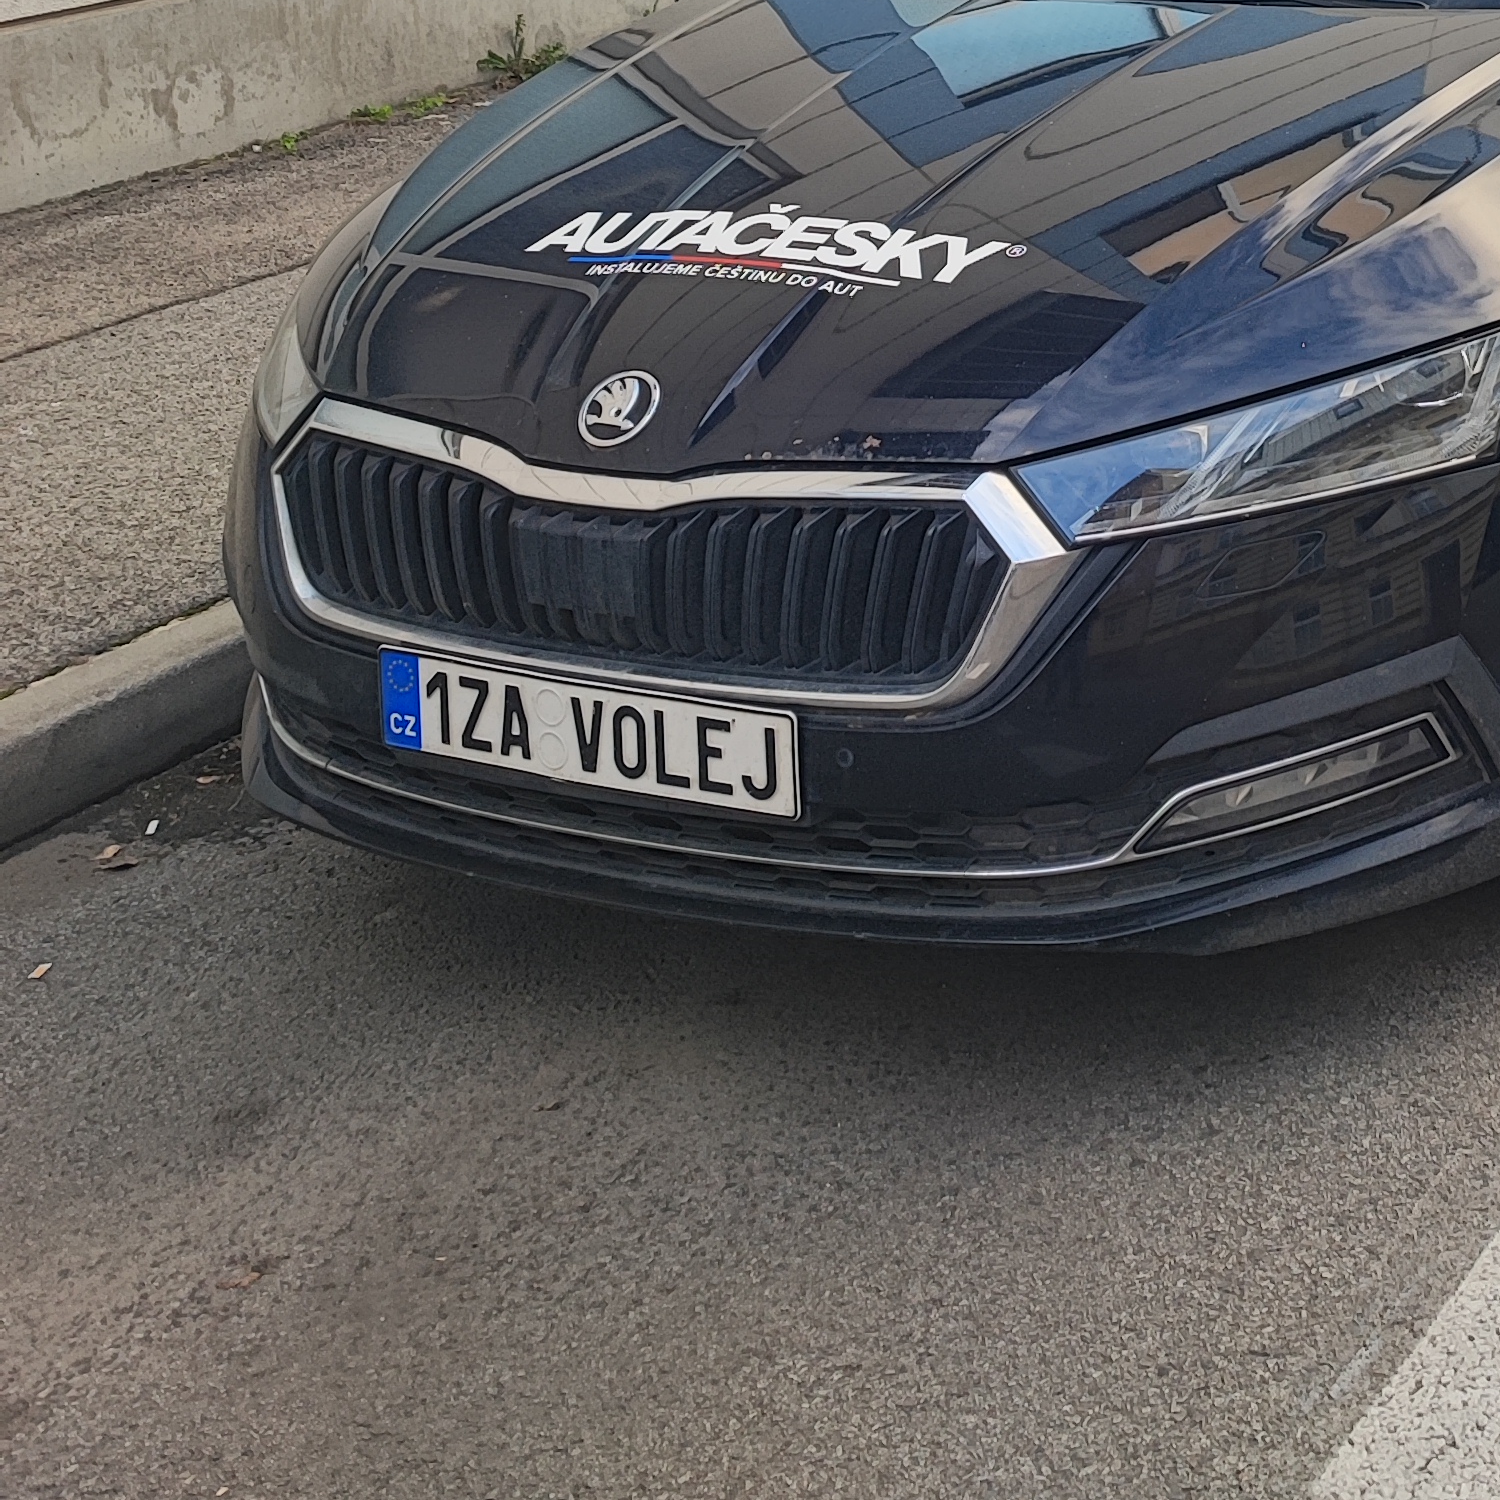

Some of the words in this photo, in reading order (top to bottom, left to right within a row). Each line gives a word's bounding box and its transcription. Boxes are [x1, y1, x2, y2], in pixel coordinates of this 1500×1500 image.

[585, 262, 703, 276] INSTALUJEME
[704, 264, 787, 284] ČEŠTINU
[785, 273, 818, 288] DO
[817, 280, 864, 298] AUT
[389, 712, 417, 737] CZ
[426, 671, 531, 760] 1ZA
[570, 696, 778, 800] VOLEJ
